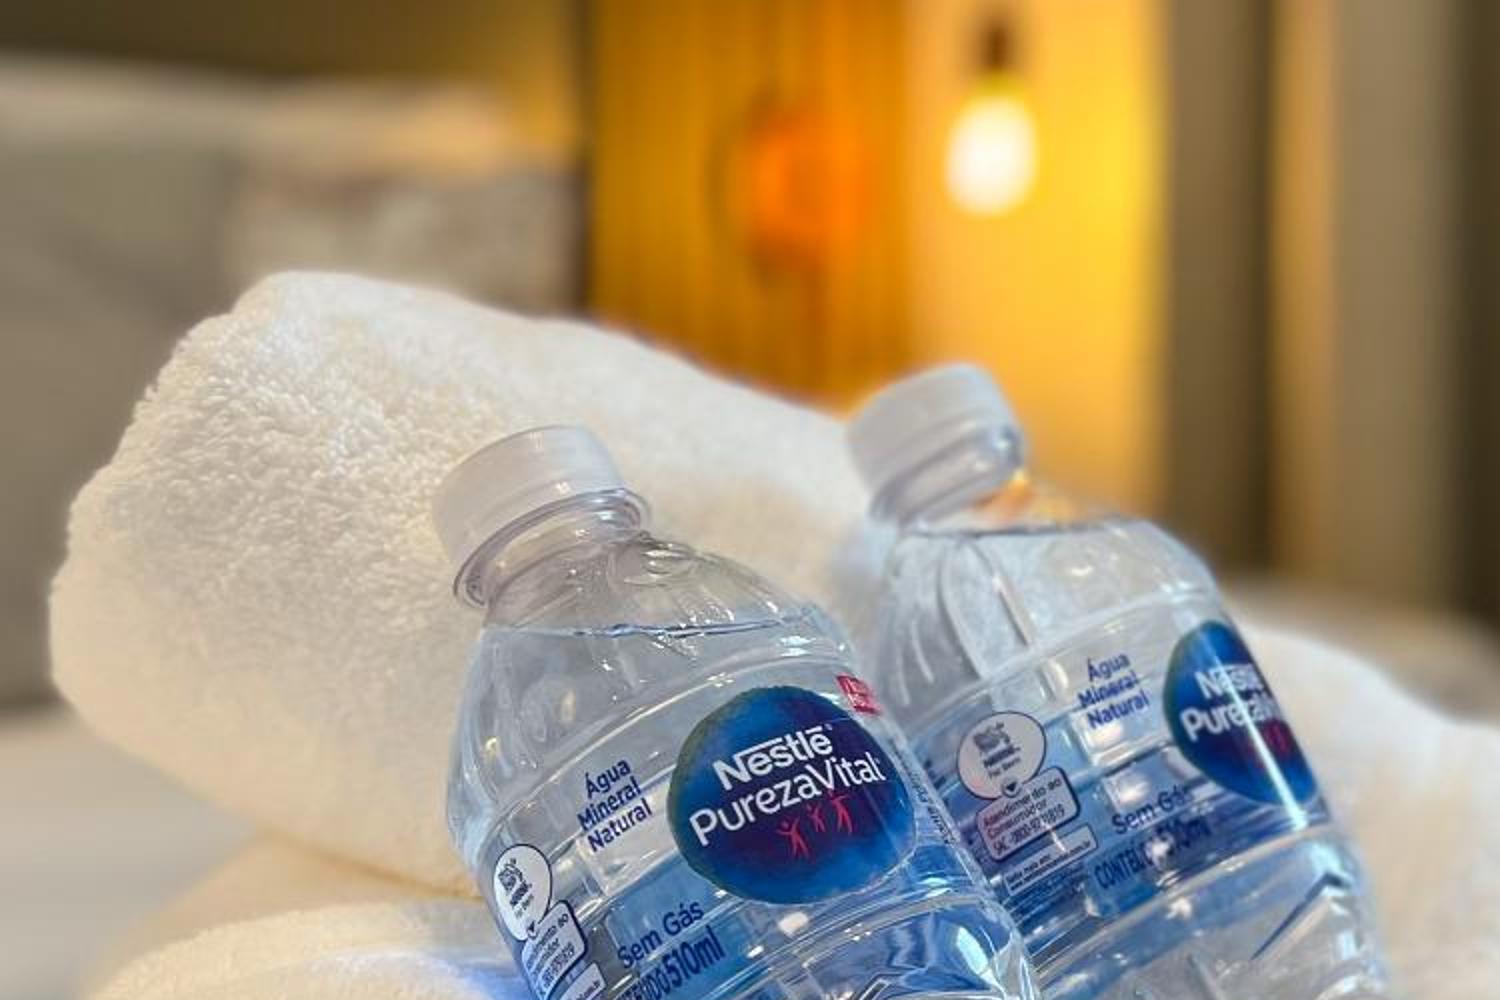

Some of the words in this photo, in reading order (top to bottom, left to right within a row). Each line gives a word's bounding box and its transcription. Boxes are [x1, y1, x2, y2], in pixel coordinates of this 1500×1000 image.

[1077, 671, 1139, 708] Mineral
[1087, 652, 1131, 682] Água
[1087, 689, 1150, 729] Natural
[584, 759, 631, 799] Água
[712, 725, 833, 791] Nestlé
[577, 776, 641, 831] Mineral
[689, 752, 886, 847] PurezaVital
[1111, 803, 1154, 835] Sem
[587, 798, 652, 851] Natural
[618, 929, 662, 969] Sem
[662, 901, 704, 936] Gás
